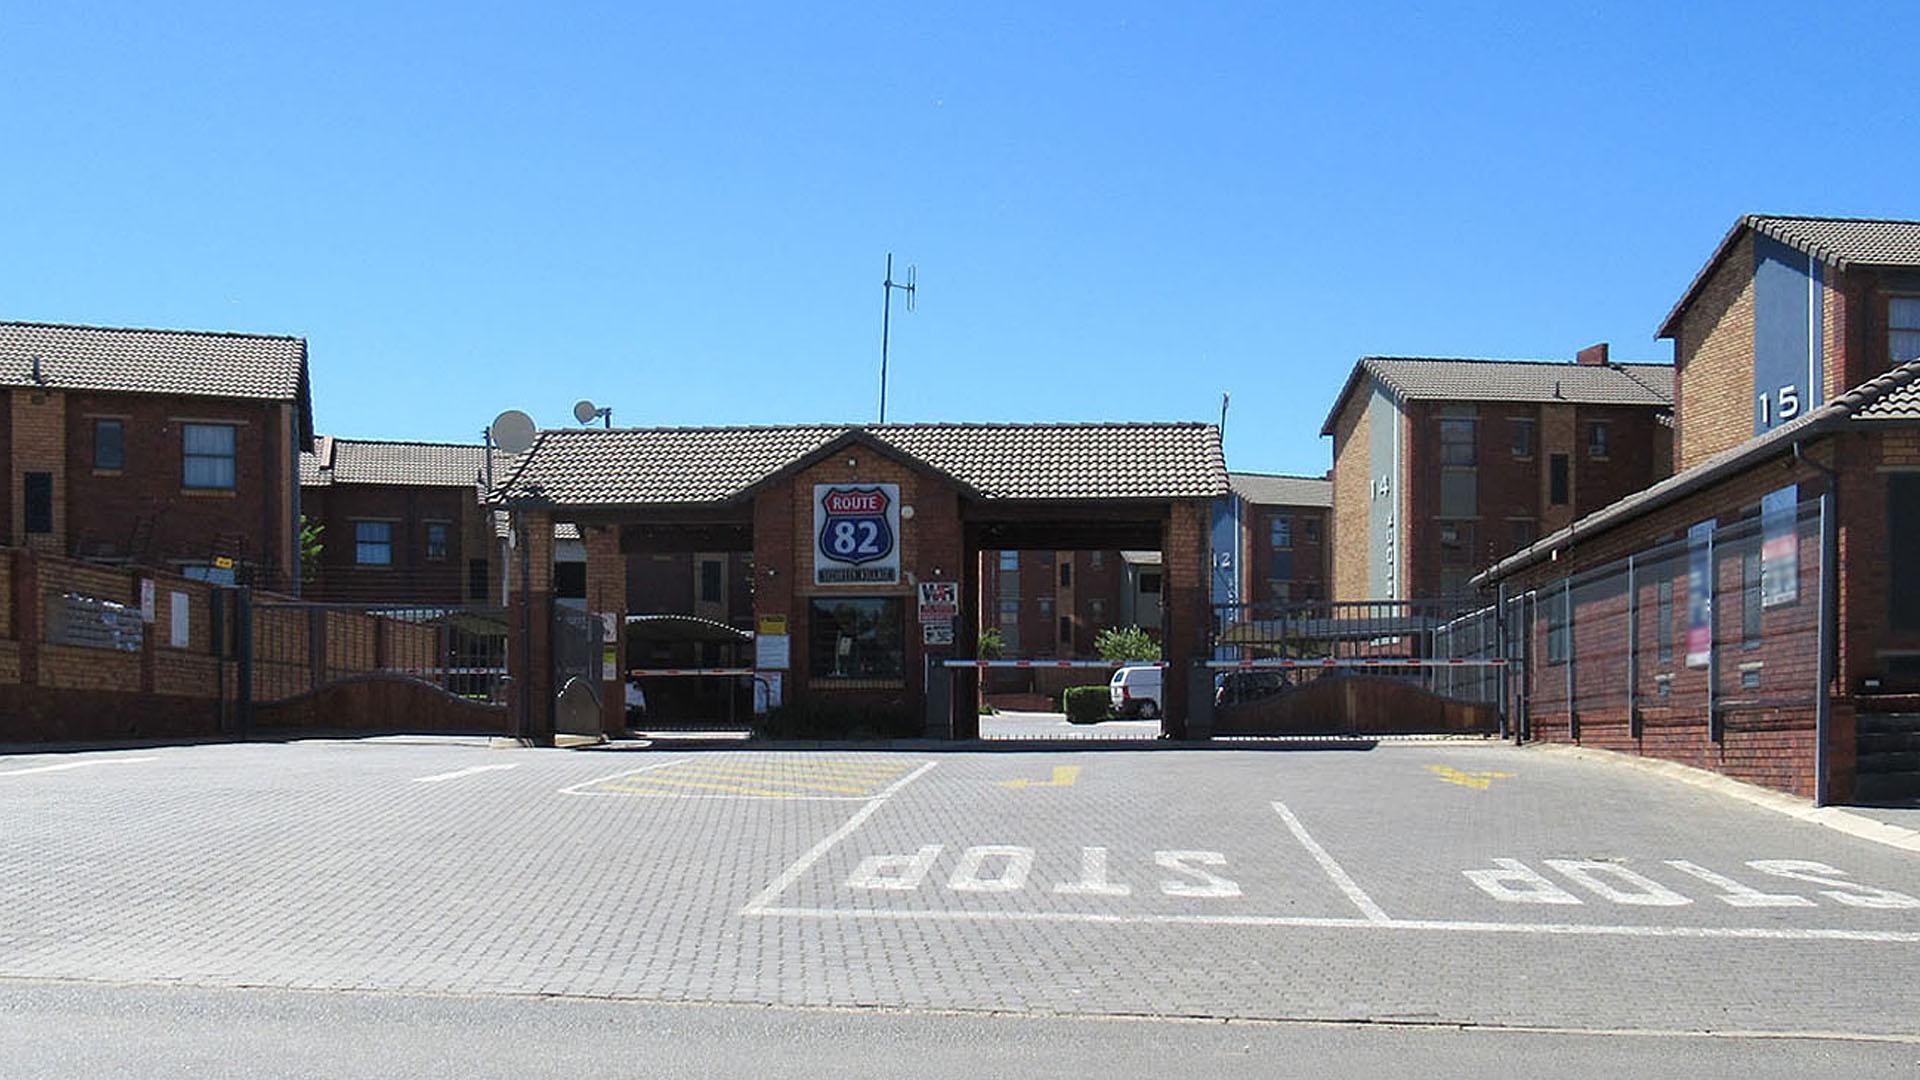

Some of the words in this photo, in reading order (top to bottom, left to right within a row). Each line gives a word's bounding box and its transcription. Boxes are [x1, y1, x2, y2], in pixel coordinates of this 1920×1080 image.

[1759, 384, 1799, 424] 15
[832, 496, 878, 510] ROUTE
[1370, 474, 1390, 501] 14
[834, 520, 879, 554] 82
[1212, 552, 1231, 568] 12
[844, 843, 1244, 898] STOP
[1460, 857, 1920, 908] STOP
